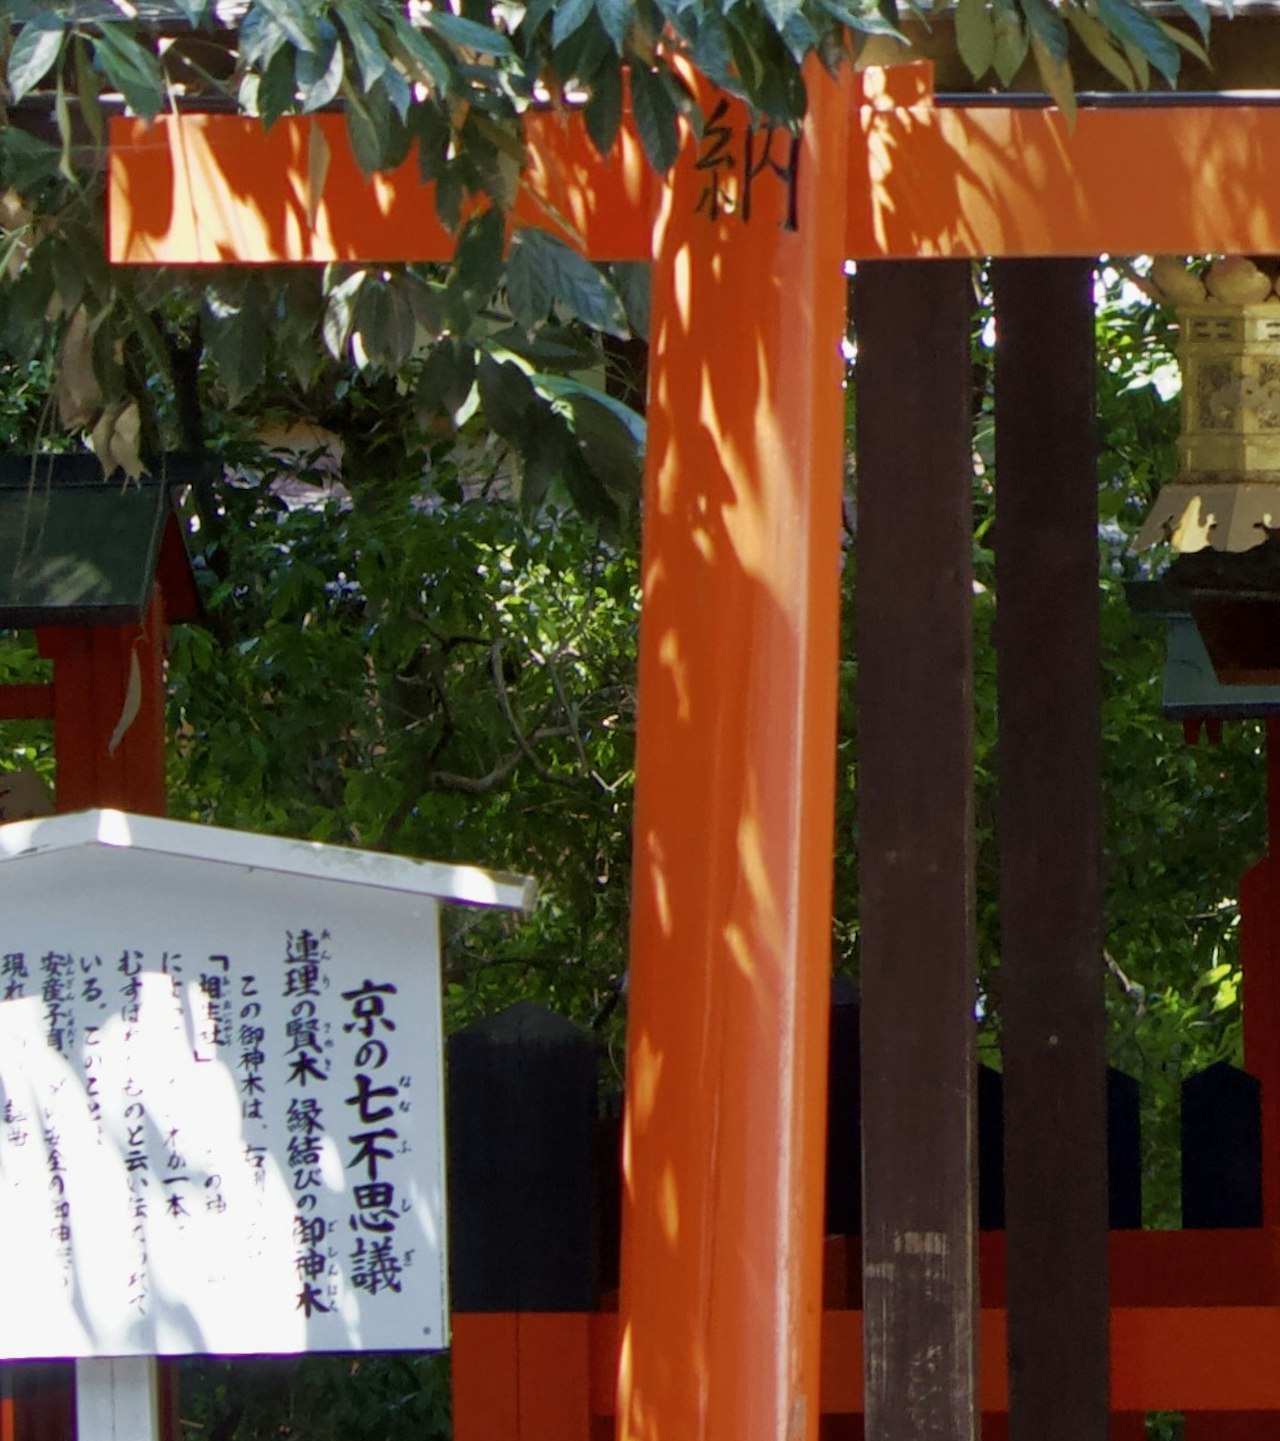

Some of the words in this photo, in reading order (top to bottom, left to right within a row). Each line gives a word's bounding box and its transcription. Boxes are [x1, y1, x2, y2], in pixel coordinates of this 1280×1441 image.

[696, 99, 800, 232] 納
[283, 929, 329, 1088] 連理の賢木
[286, 1097, 331, 1319] 縁結びの御神木
[340, 979, 403, 1296] 京の七不思議
